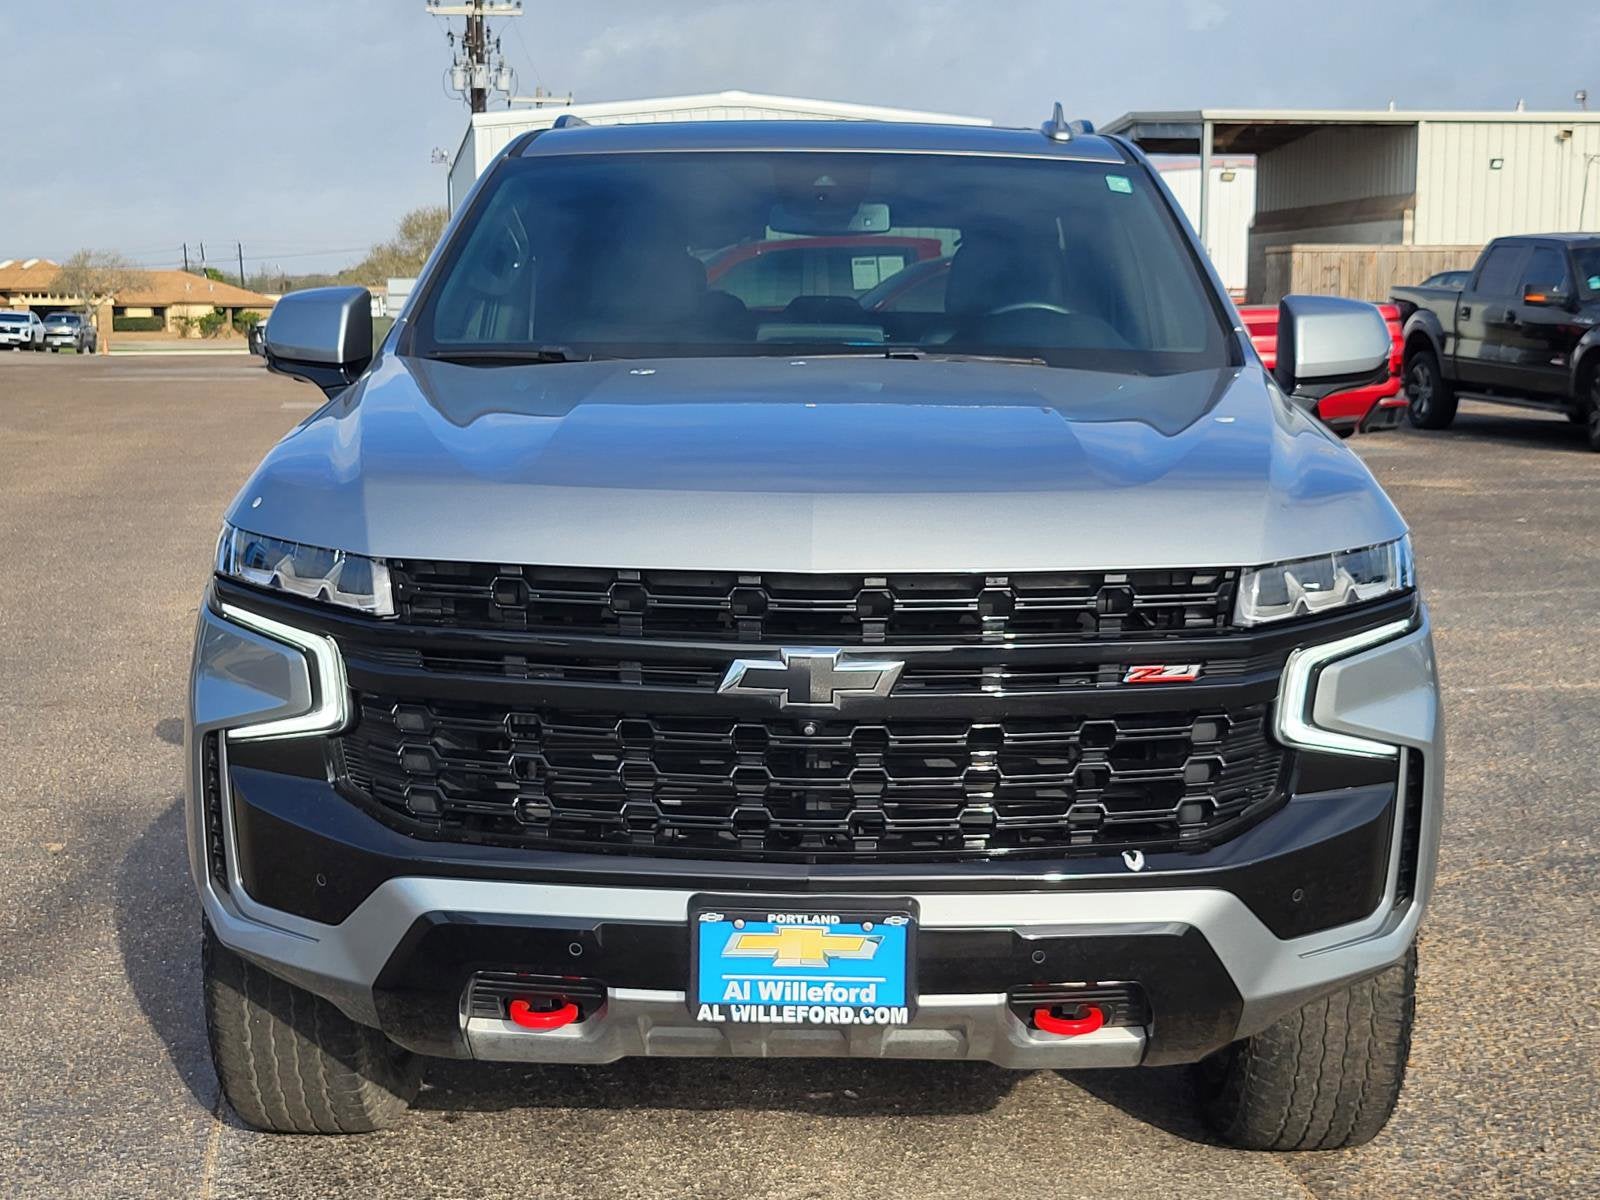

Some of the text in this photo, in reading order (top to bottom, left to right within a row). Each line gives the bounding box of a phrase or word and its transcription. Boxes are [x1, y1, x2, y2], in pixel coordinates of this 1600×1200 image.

[1123, 665, 1201, 683] Z71
[767, 914, 840, 924] PORTLAND
[723, 980, 876, 1003] Al Willeford
[697, 1004, 908, 1024] AL WILLEFORD.COM
